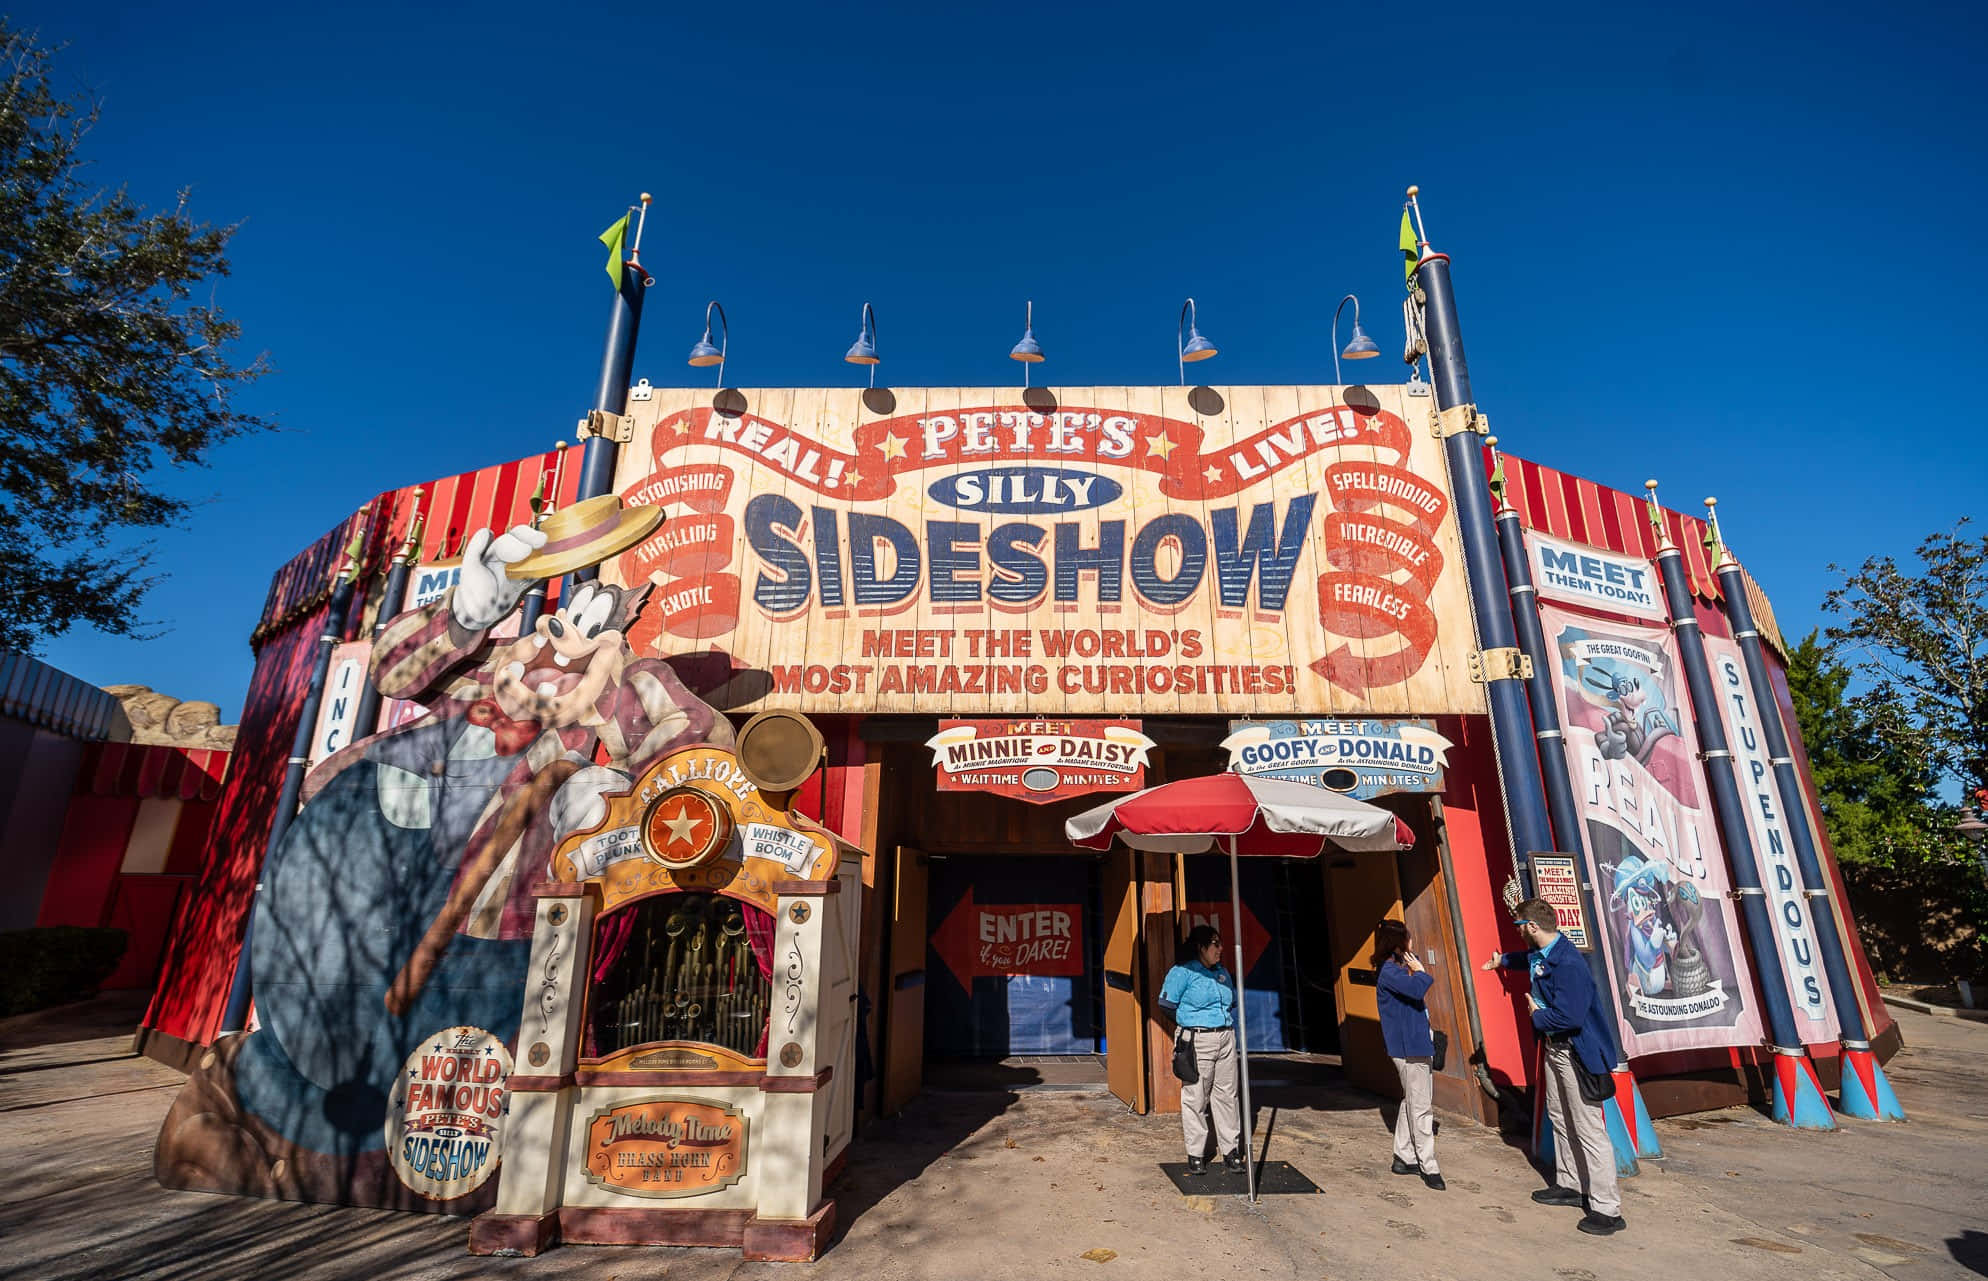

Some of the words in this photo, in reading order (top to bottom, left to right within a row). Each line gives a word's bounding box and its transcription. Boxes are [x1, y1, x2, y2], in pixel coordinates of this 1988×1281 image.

[917, 412, 1139, 460] PETE'S
[1229, 409, 1359, 481] LIVE!
[704, 413, 847, 489] REAL!
[628, 473, 725, 507] ASTONISHING
[955, 475, 1097, 506] SILLY
[1332, 471, 1441, 514] SPELLBINDING
[635, 523, 717, 563] THRILLING
[744, 492, 1319, 619] SIDESHOW
[1340, 523, 1430, 566] INCREDIBLE
[1541, 546, 1645, 590] MEET
[660, 586, 712, 616] EXOTIC
[1545, 571, 1592, 591] THEM
[1595, 583, 1651, 605] TODAY!
[1334, 584, 1411, 621] FEARLESS
[862, 630, 956, 658] MEET
[964, 630, 1031, 658] THE
[1041, 629, 1203, 658] WORLD'S
[1586, 644, 1600, 654] THE
[1601, 645, 1622, 656] GREAT
[1623, 648, 1651, 664] GOOFINI
[773, 665, 876, 694] MOST
[881, 665, 1048, 694] AMAZING
[1057, 665, 1296, 694] CURIOSITIES!
[1007, 722, 1074, 735] MEET
[1301, 722, 1368, 736] MEET
[948, 739, 1032, 764] MINNIE
[1038, 745, 1056, 754] AND
[1060, 740, 1137, 764] DAISY
[962, 760, 986, 769] MINNIE
[1242, 739, 1319, 765] GOOFY
[1320, 746, 1336, 754] AND
[1338, 739, 1434, 765] DONALD
[1268, 760, 1289, 768] GREAT
[1107, 764, 1134, 772] FORTUNA
[1357, 758, 1399, 767] ASTOUNDING
[1401, 762, 1434, 773] DONALDO
[640, 758, 758, 804] CALLIOPE
[961, 774, 991, 785] WAIT
[992, 774, 1018, 785] TIME
[1063, 774, 1119, 785] MINUTES
[1362, 775, 1420, 785] MINUTES
[597, 831, 638, 847] TOOT
[753, 827, 807, 851] WHISTLE
[1724, 662, 1821, 1005] STUPENDOUS
[595, 844, 641, 865] PLUNK
[755, 842, 793, 861] BOOM
[1544, 868, 1564, 876] MEET
[980, 911, 1071, 943] ENTER
[1554, 908, 1580, 926] DAY
[1016, 939, 1071, 966] DARE!
[1648, 1003, 1688, 1016] ASTOUNDING
[1688, 996, 1720, 1013] DONALDO
[421, 1055, 501, 1084] WORLD
[405, 1083, 504, 1119] FAMOUS
[424, 1113, 479, 1128] PETE'S
[601, 1111, 683, 1149] Melody
[685, 1115, 732, 1141] Time
[403, 1136, 491, 1181] SIDESHOW
[617, 1152, 665, 1168] BRASS
[670, 1152, 711, 1168] HORN
[642, 1169, 684, 1183] BAND
